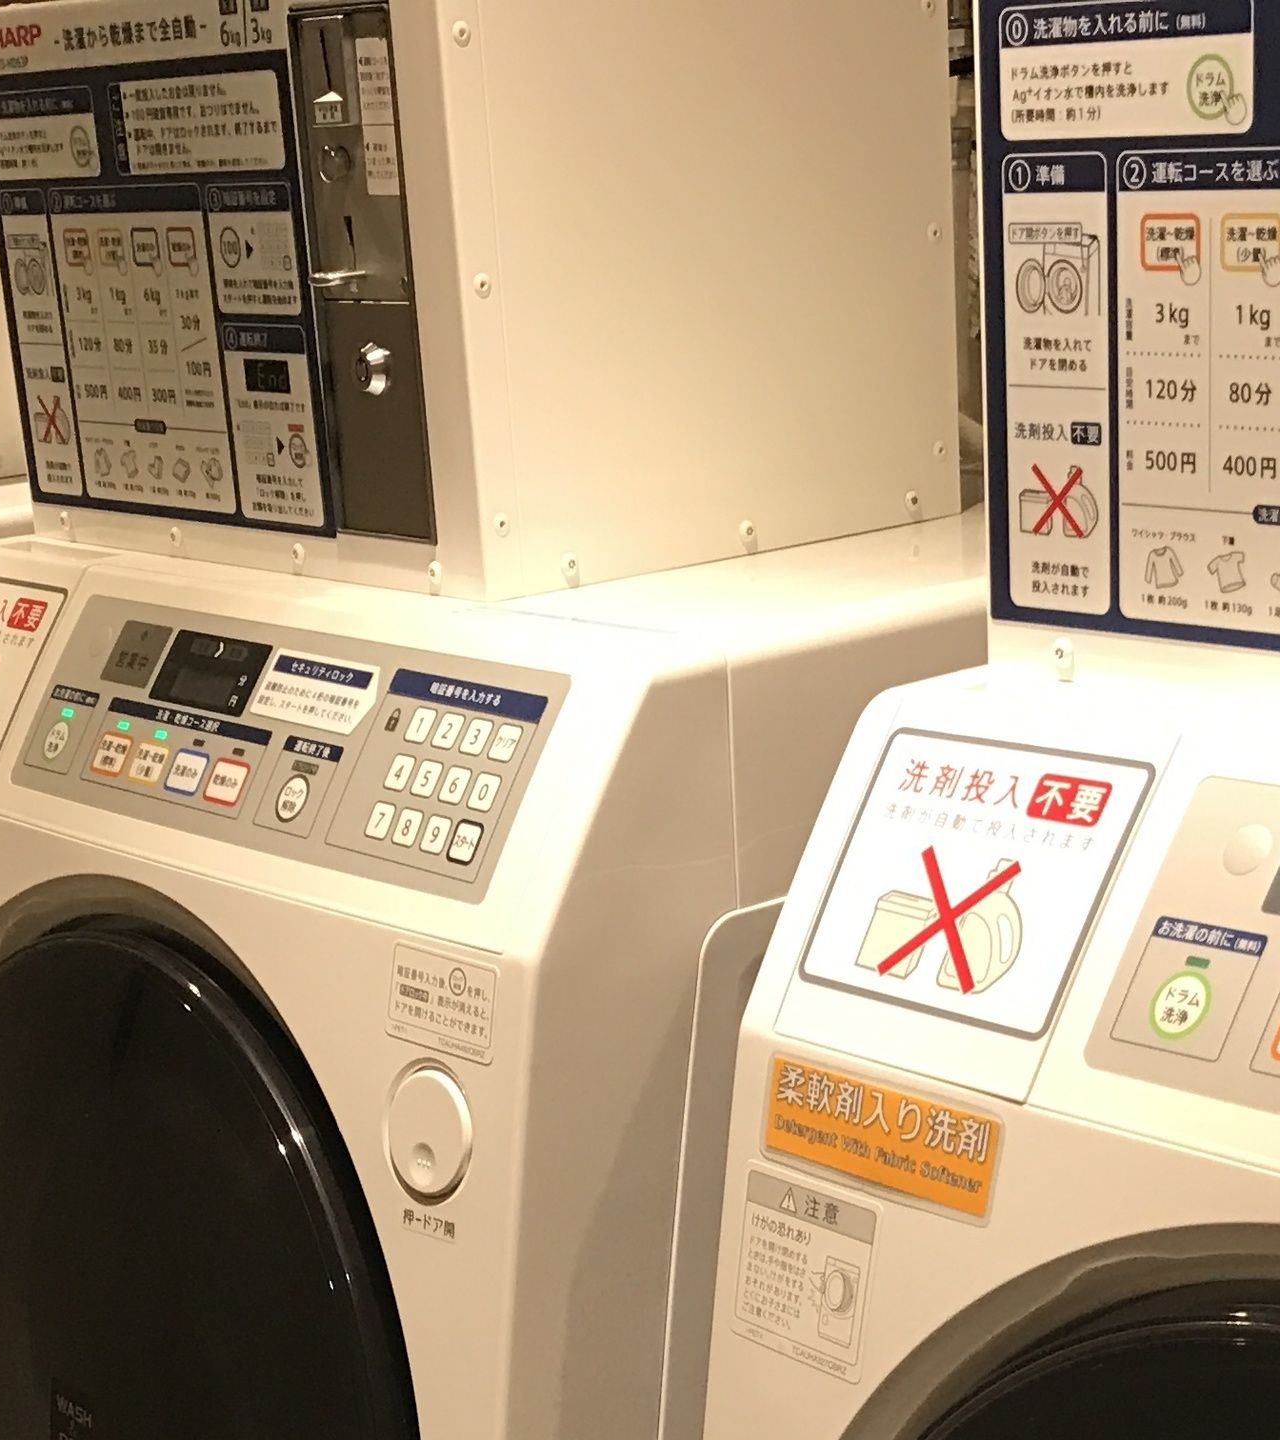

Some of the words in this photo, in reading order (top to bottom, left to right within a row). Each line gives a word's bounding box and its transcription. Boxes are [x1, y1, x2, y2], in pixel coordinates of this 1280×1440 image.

[220, 21, 241, 47] 6kg
[250, 18, 272, 44] 3kg
[1033, 12, 1169, 40] 洗濯物を入れる前に
[1151, 160, 1280, 184] 運転コースを選ぶ
[1155, 303, 1190, 328] 3kg
[1236, 304, 1271, 331] 1kg
[1023, 337, 1092, 351] 洗濯物を入れて
[1145, 379, 1197, 402] 120分
[1229, 382, 1272, 406] 80分
[1014, 421, 1069, 442] 洗剤投入
[1073, 424, 1099, 444] 不要
[1145, 450, 1197, 475] 500円
[1222, 455, 1277, 480] 400円
[11, 602, 45, 628] 不要
[237, 675, 248, 687] 分
[417, 717, 424, 733] 1
[441, 723, 453, 740] 2
[469, 728, 481, 745] 3
[393, 765, 404, 781] 4
[420, 770, 432, 787] 5
[448, 777, 458, 794] 6
[478, 784, 489, 801] 0
[899, 759, 1020, 809] 洗剤投入
[1036, 781, 1108, 822] 不要
[374, 812, 386, 829] 7
[401, 819, 412, 836] 8
[430, 826, 441, 843] 9
[1157, 919, 1233, 946] お洗濯の前に
[1164, 986, 1200, 1008] ドラム
[1161, 1007, 1190, 1026] 洗浄
[777, 1065, 991, 1162] 柔軟剤入り洗剤
[875, 1146, 917, 1175] Fabric
[920, 1161, 983, 1193] Softener
[804, 1195, 840, 1225] 注意
[56, 1394, 92, 1429] WASH
